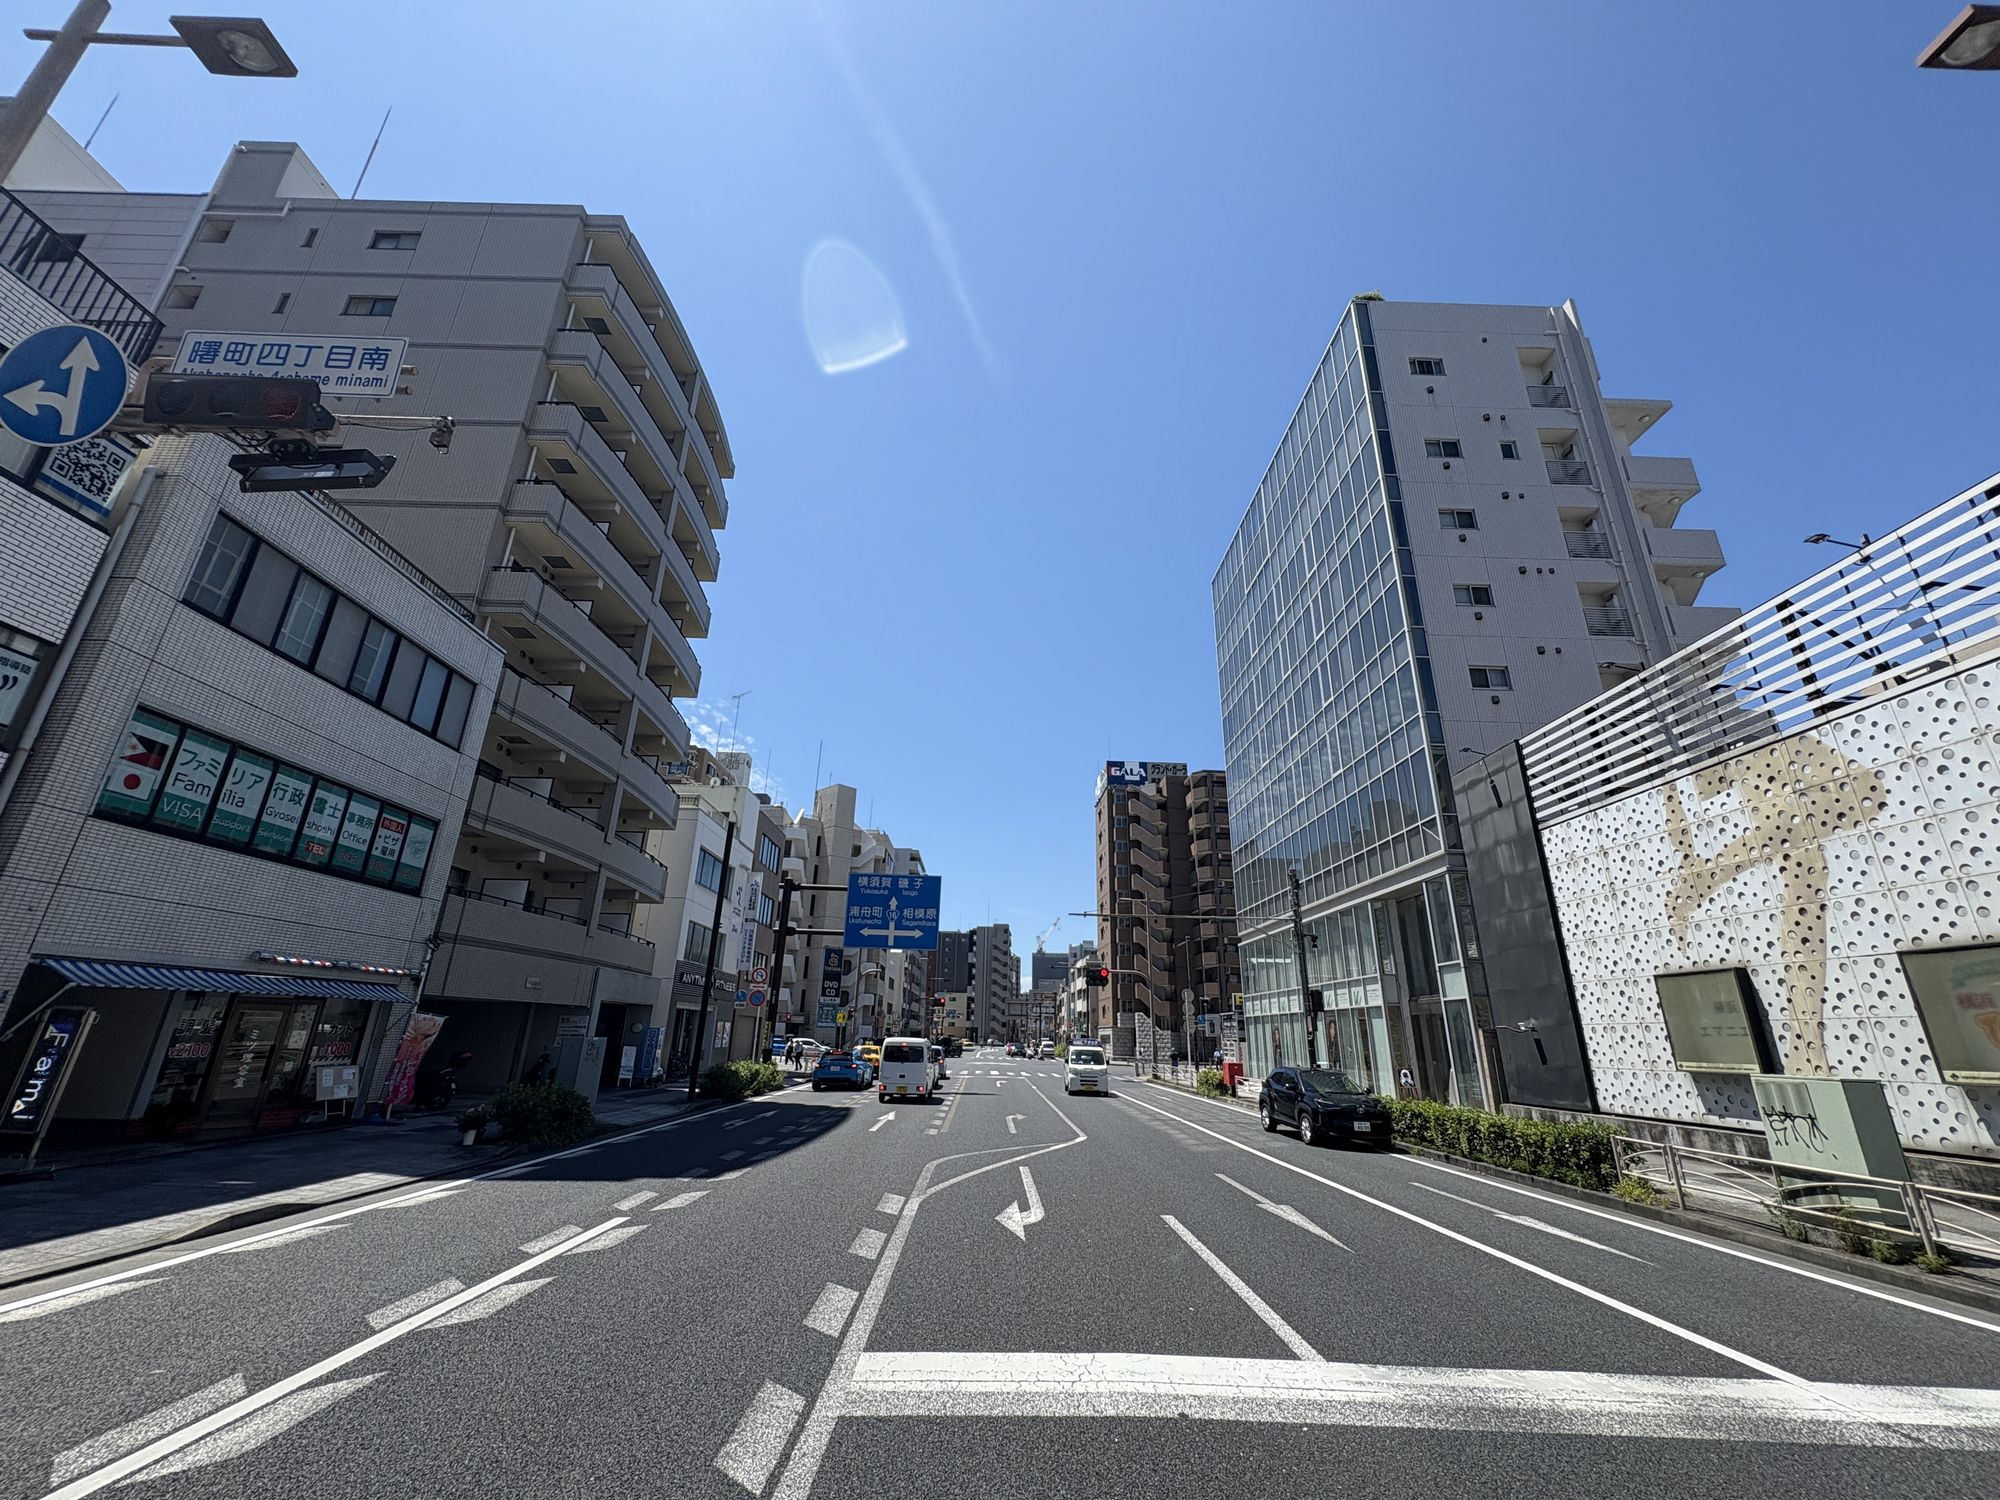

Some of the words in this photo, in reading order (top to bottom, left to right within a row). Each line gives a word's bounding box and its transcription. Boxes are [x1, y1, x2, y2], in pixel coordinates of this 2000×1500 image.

[187, 340, 392, 371] 曙町四丁目南
[335, 373, 389, 388] minami
[1109, 766, 1146, 777] GALA
[171, 772, 246, 808] Familia
[163, 797, 203, 821] VISA
[212, 815, 251, 833] Support
[341, 830, 368, 846] Office
[383, 834, 400, 846] ビザ
[308, 842, 325, 855] TEL
[858, 876, 892, 889] 横須賀
[898, 877, 924, 890] 磯子
[860, 887, 888, 895] Yokosuka
[848, 905, 883, 918] 浦舟町
[902, 908, 937, 920] 相模原
[901, 918, 937, 928] Sagamihara
[682, 972, 706, 986] ANYTIM
[714, 979, 736, 992] FITNESS
[824, 980, 839, 988] DVD
[825, 988, 836, 996] CD
[327, 1024, 353, 1036] カット
